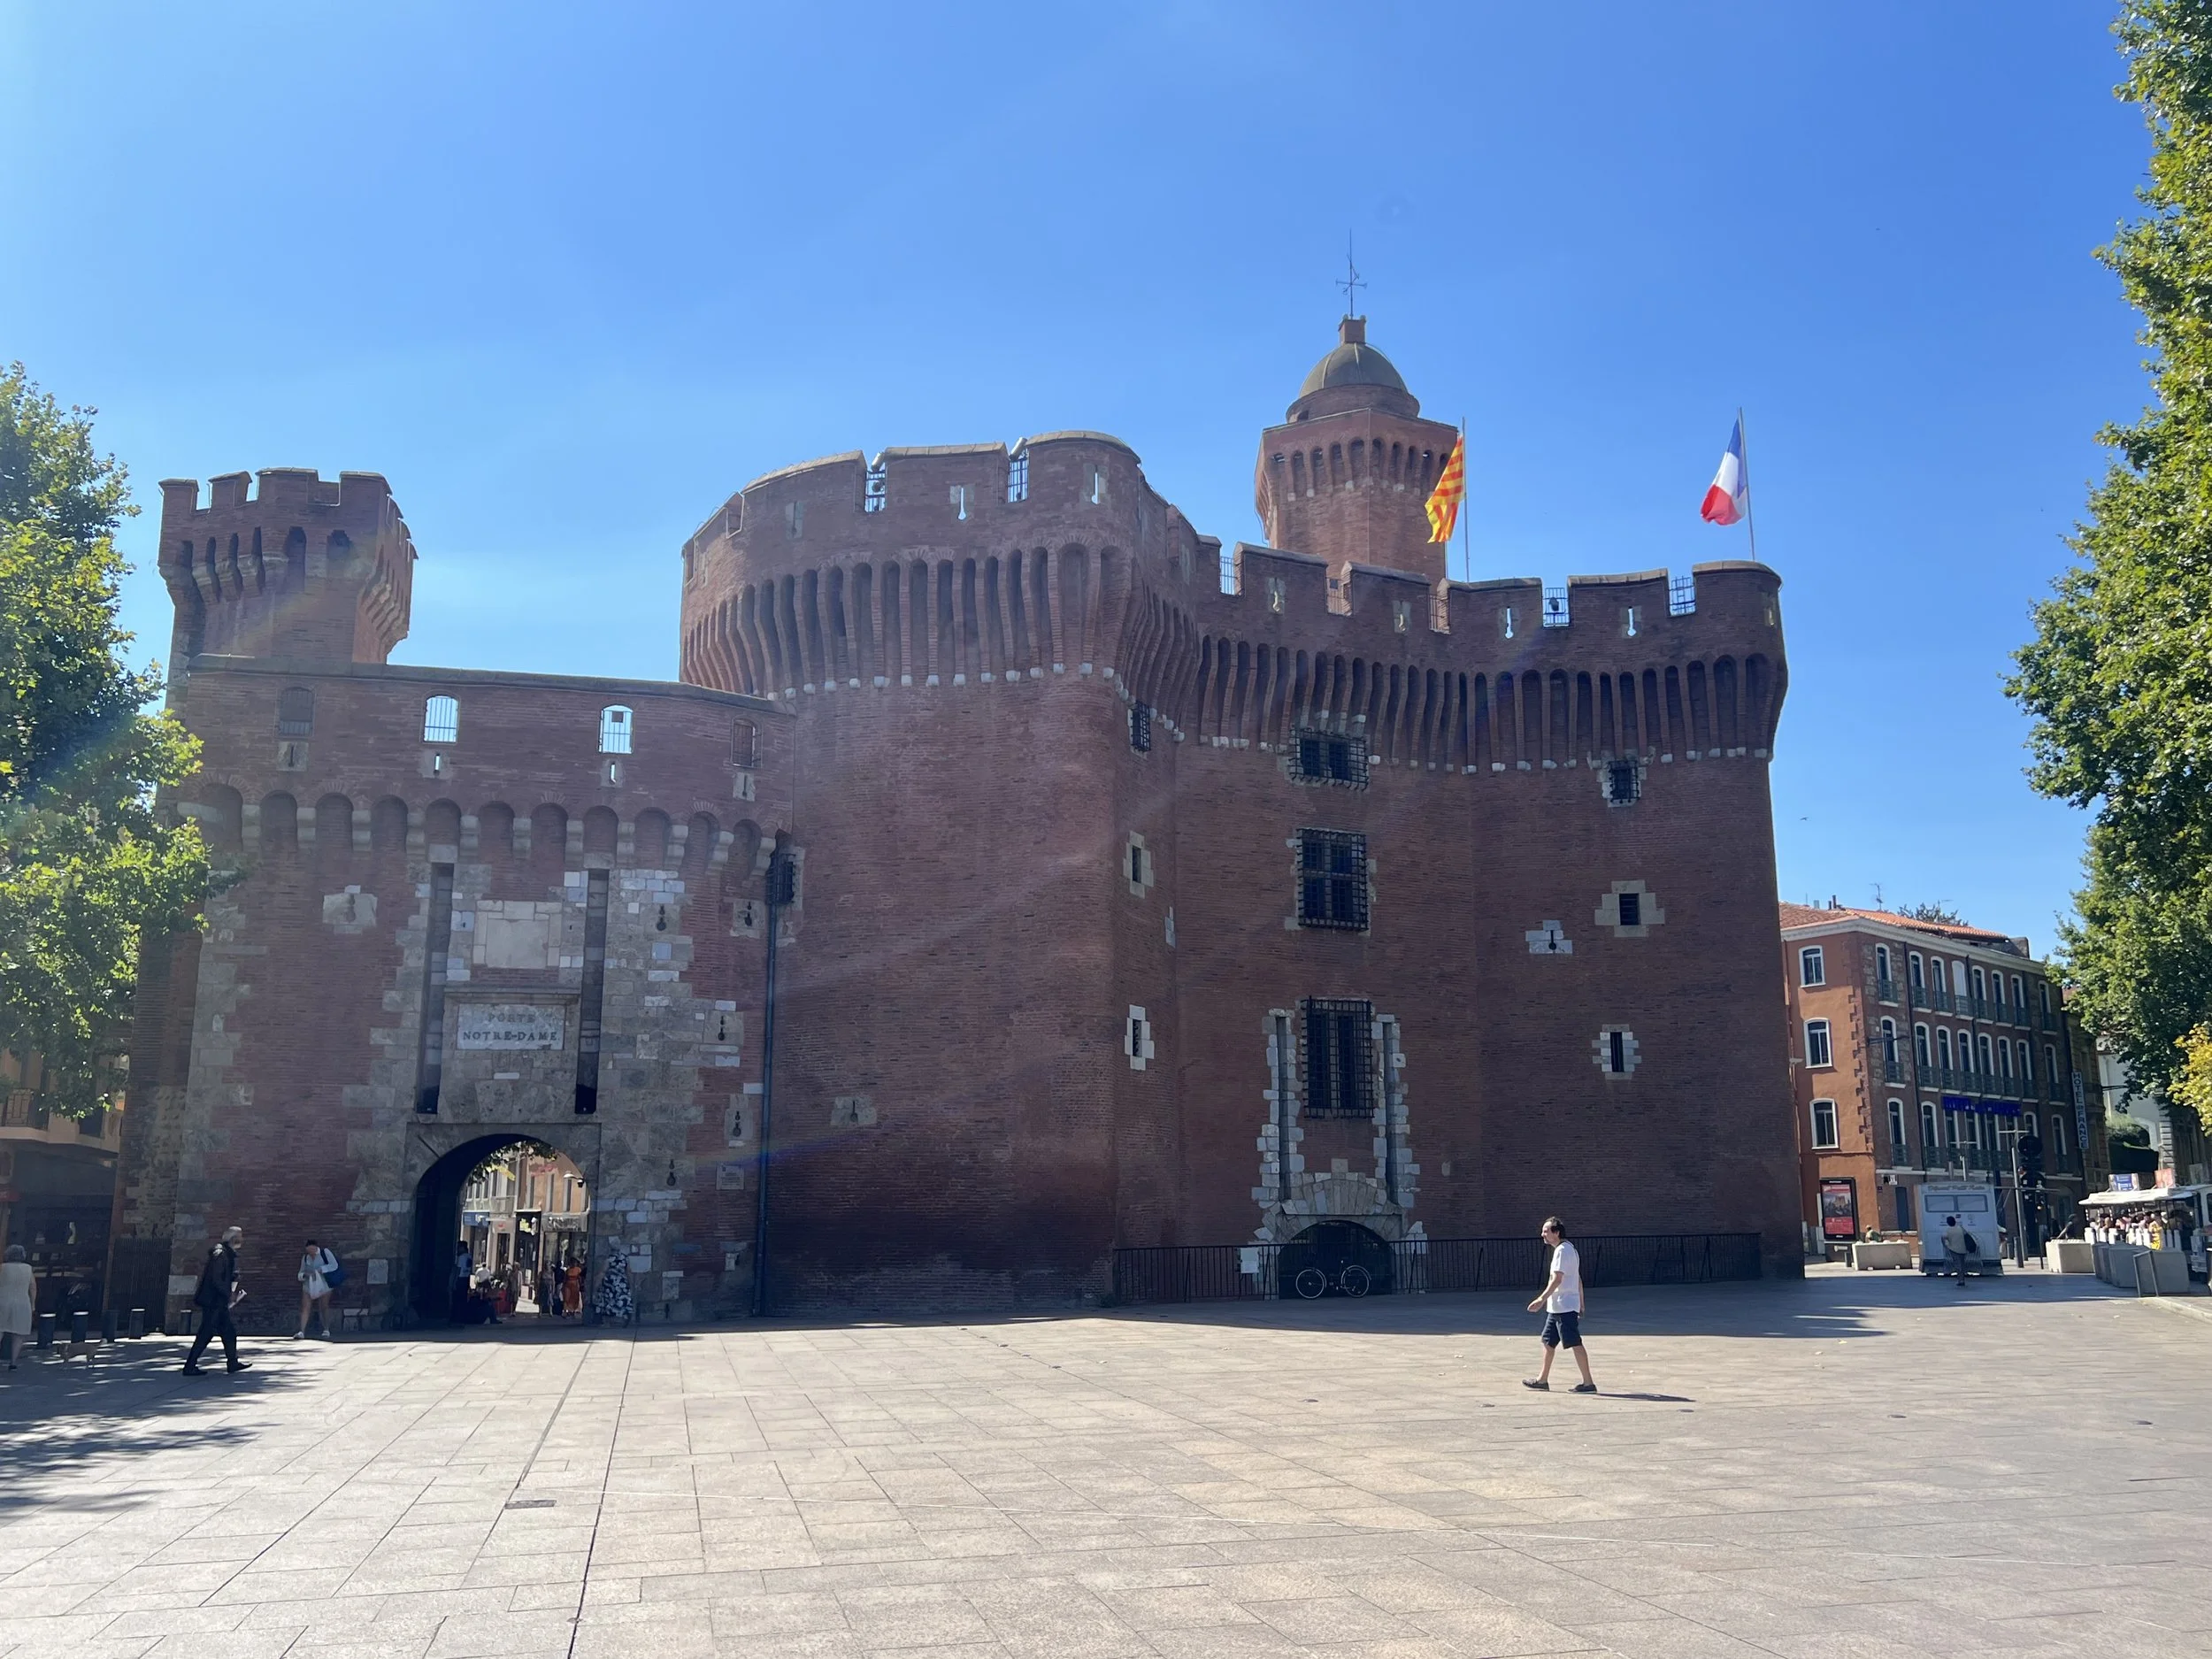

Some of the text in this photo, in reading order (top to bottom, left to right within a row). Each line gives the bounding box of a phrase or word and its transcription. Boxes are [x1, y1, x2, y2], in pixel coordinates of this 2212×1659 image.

[488, 1012, 536, 1024] PORTE
[2073, 1072, 2082, 1104] HOTEL
[2078, 1110, 2087, 1148] FRANCE
